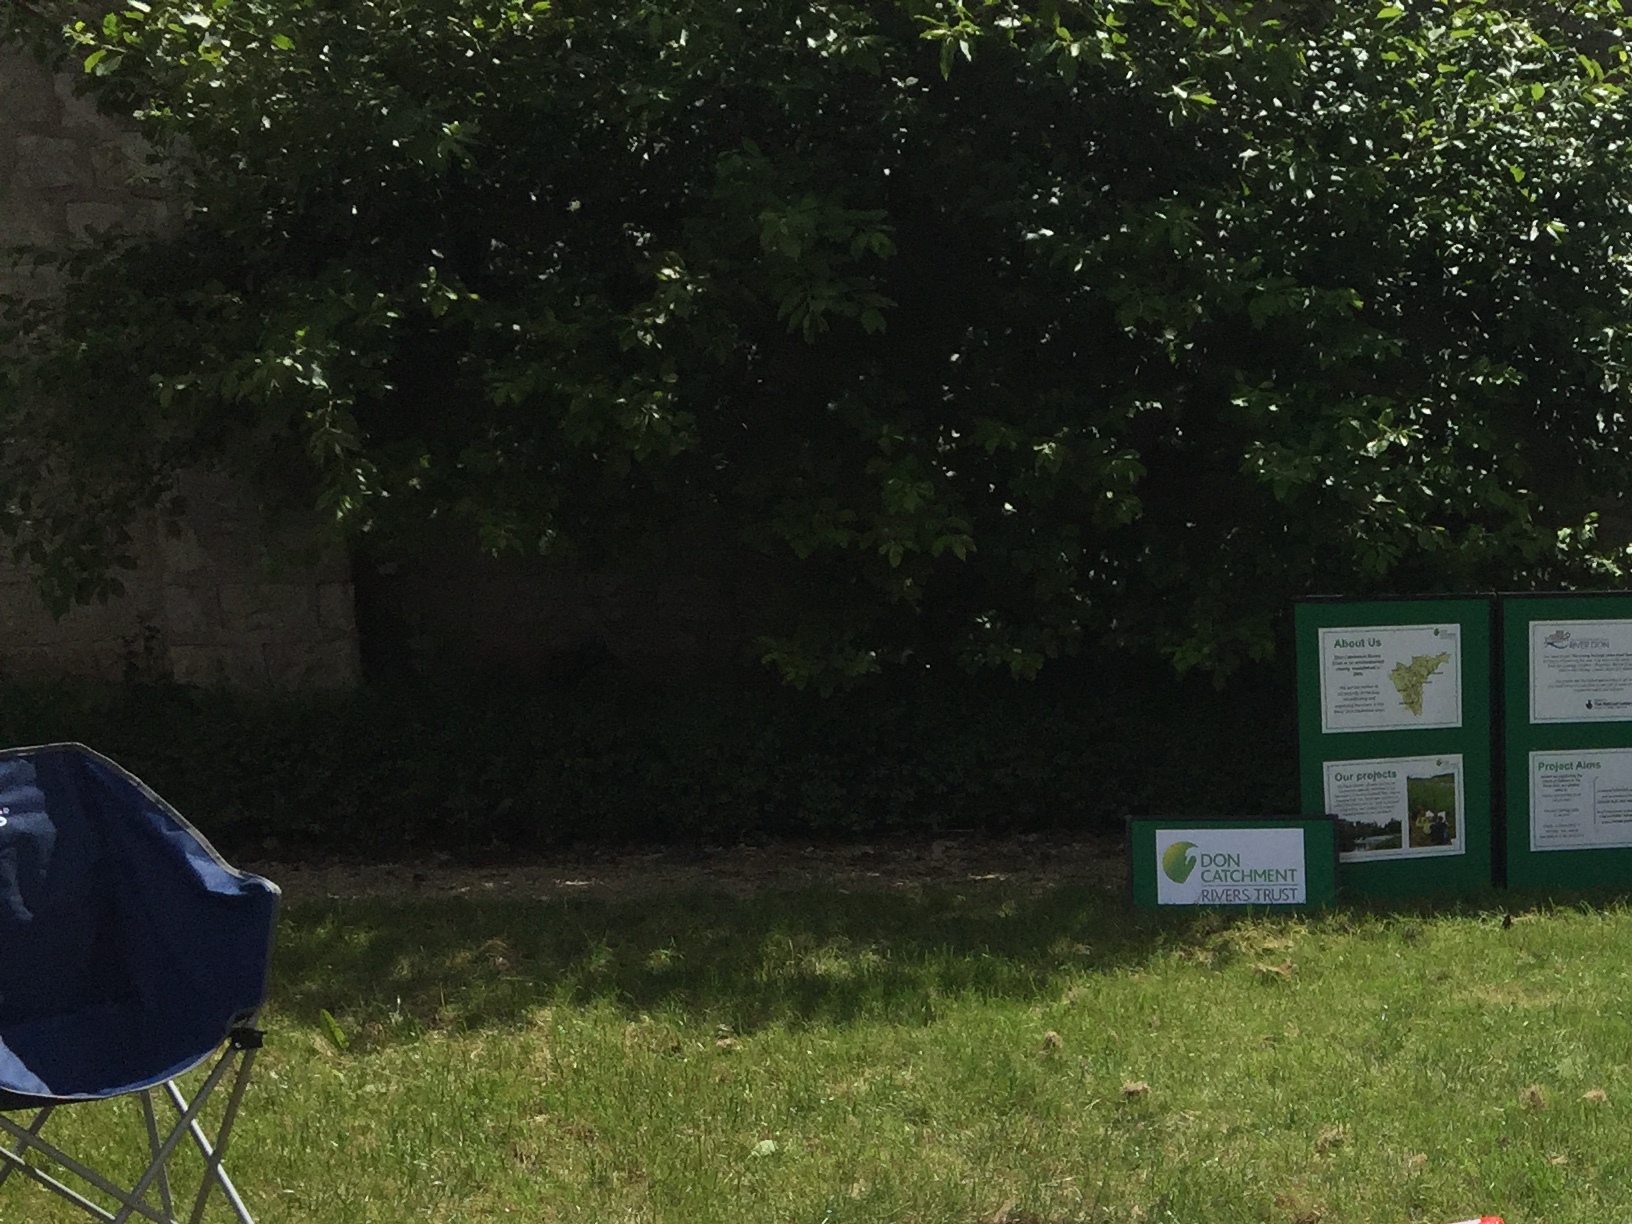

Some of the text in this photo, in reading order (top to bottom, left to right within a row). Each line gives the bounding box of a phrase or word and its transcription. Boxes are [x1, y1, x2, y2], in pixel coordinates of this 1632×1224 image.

[1334, 637, 1382, 648] About Us
[1538, 760, 1602, 772] Project Aims
[1335, 770, 1397, 782] Our projects
[1201, 853, 1240, 867] DON
[1200, 868, 1297, 883] CATCHMENT
[1201, 888, 1298, 903] RIVERS TRUST
